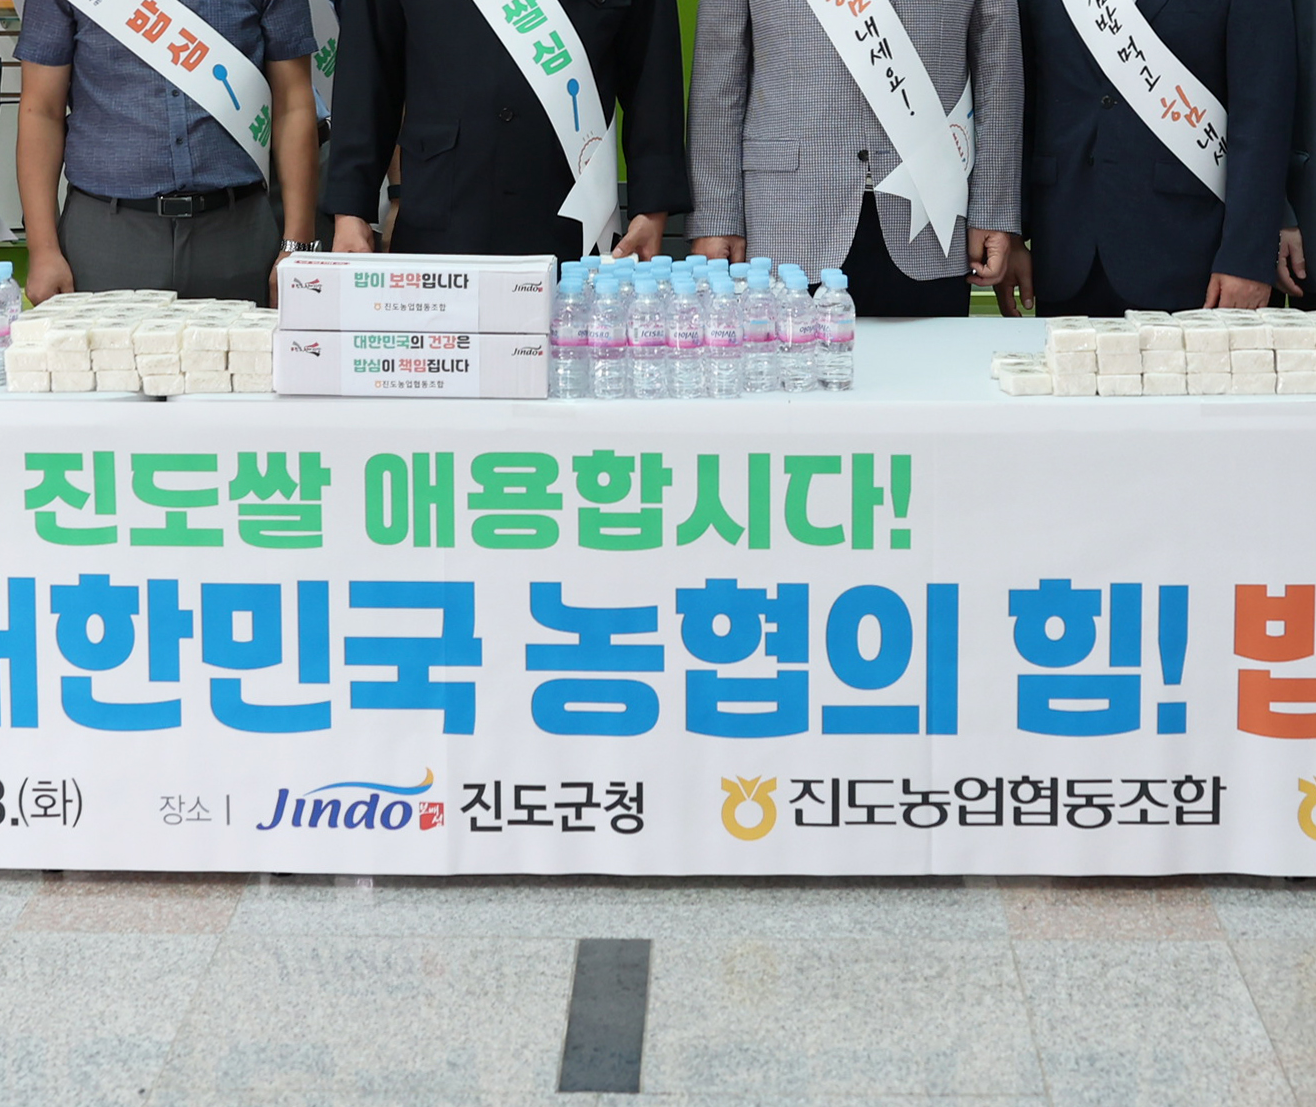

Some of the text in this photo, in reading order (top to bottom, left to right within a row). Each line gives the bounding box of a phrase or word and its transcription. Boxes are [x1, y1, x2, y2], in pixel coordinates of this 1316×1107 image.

[854, 16, 916, 116] 내세요!
[1117, 35, 1162, 93] 먹고
[1160, 85, 1208, 130] 힘
[354, 272, 470, 290] 밥이 보약입니다
[384, 302, 446, 312] 진도농업협동조합
[353, 335, 471, 350] 대한민국의 건강은
[353, 358, 470, 374] 밥심이 책임집니다
[24, 450, 332, 550] 진도쌀
[363, 449, 912, 551] 애용합시다!
[524, 577, 960, 739] 농협의
[1008, 578, 1190, 737] 힘!
[159, 792, 213, 825] 장소
[256, 786, 413, 832] Jindo
[460, 778, 646, 834] 진도군청
[788, 774, 1227, 830] 진도농업협동조합
